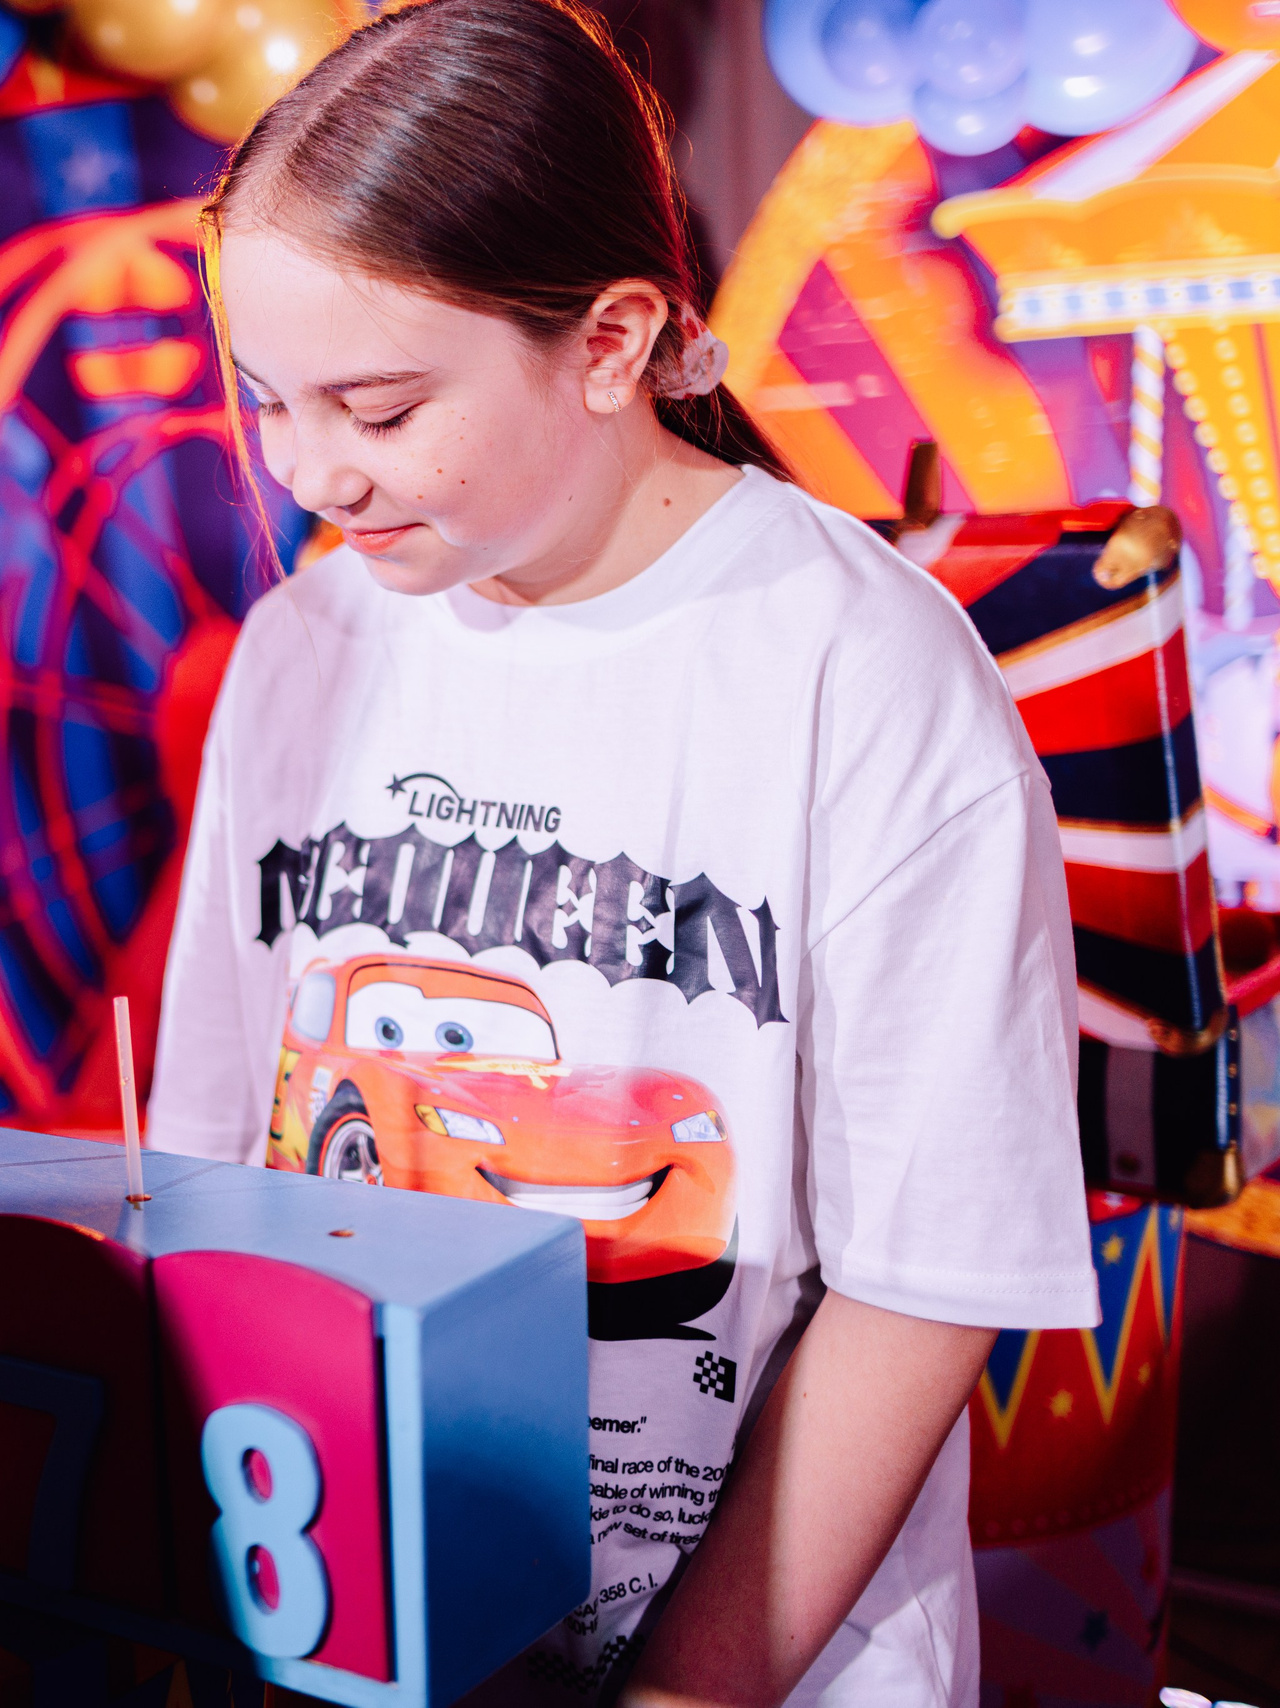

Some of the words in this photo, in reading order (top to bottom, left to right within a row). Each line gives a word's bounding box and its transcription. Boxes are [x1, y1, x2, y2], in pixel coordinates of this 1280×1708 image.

[408, 790, 562, 833] LIGHTNING
[622, 1461, 654, 1475] race
[657, 1456, 673, 1473] of
[675, 1458, 700, 1478] the
[630, 1484, 647, 1498] of
[649, 1483, 705, 1506] winning
[612, 1504, 626, 1515] to
[629, 1503, 651, 1519] do
[653, 1510, 674, 1524] so,
[201, 1402, 331, 1660] 8
[597, 1520, 623, 1543] new
[623, 1522, 648, 1540] set
[650, 1531, 668, 1543] of
[599, 1582, 626, 1603] 358
[629, 1577, 646, 1594] C.
